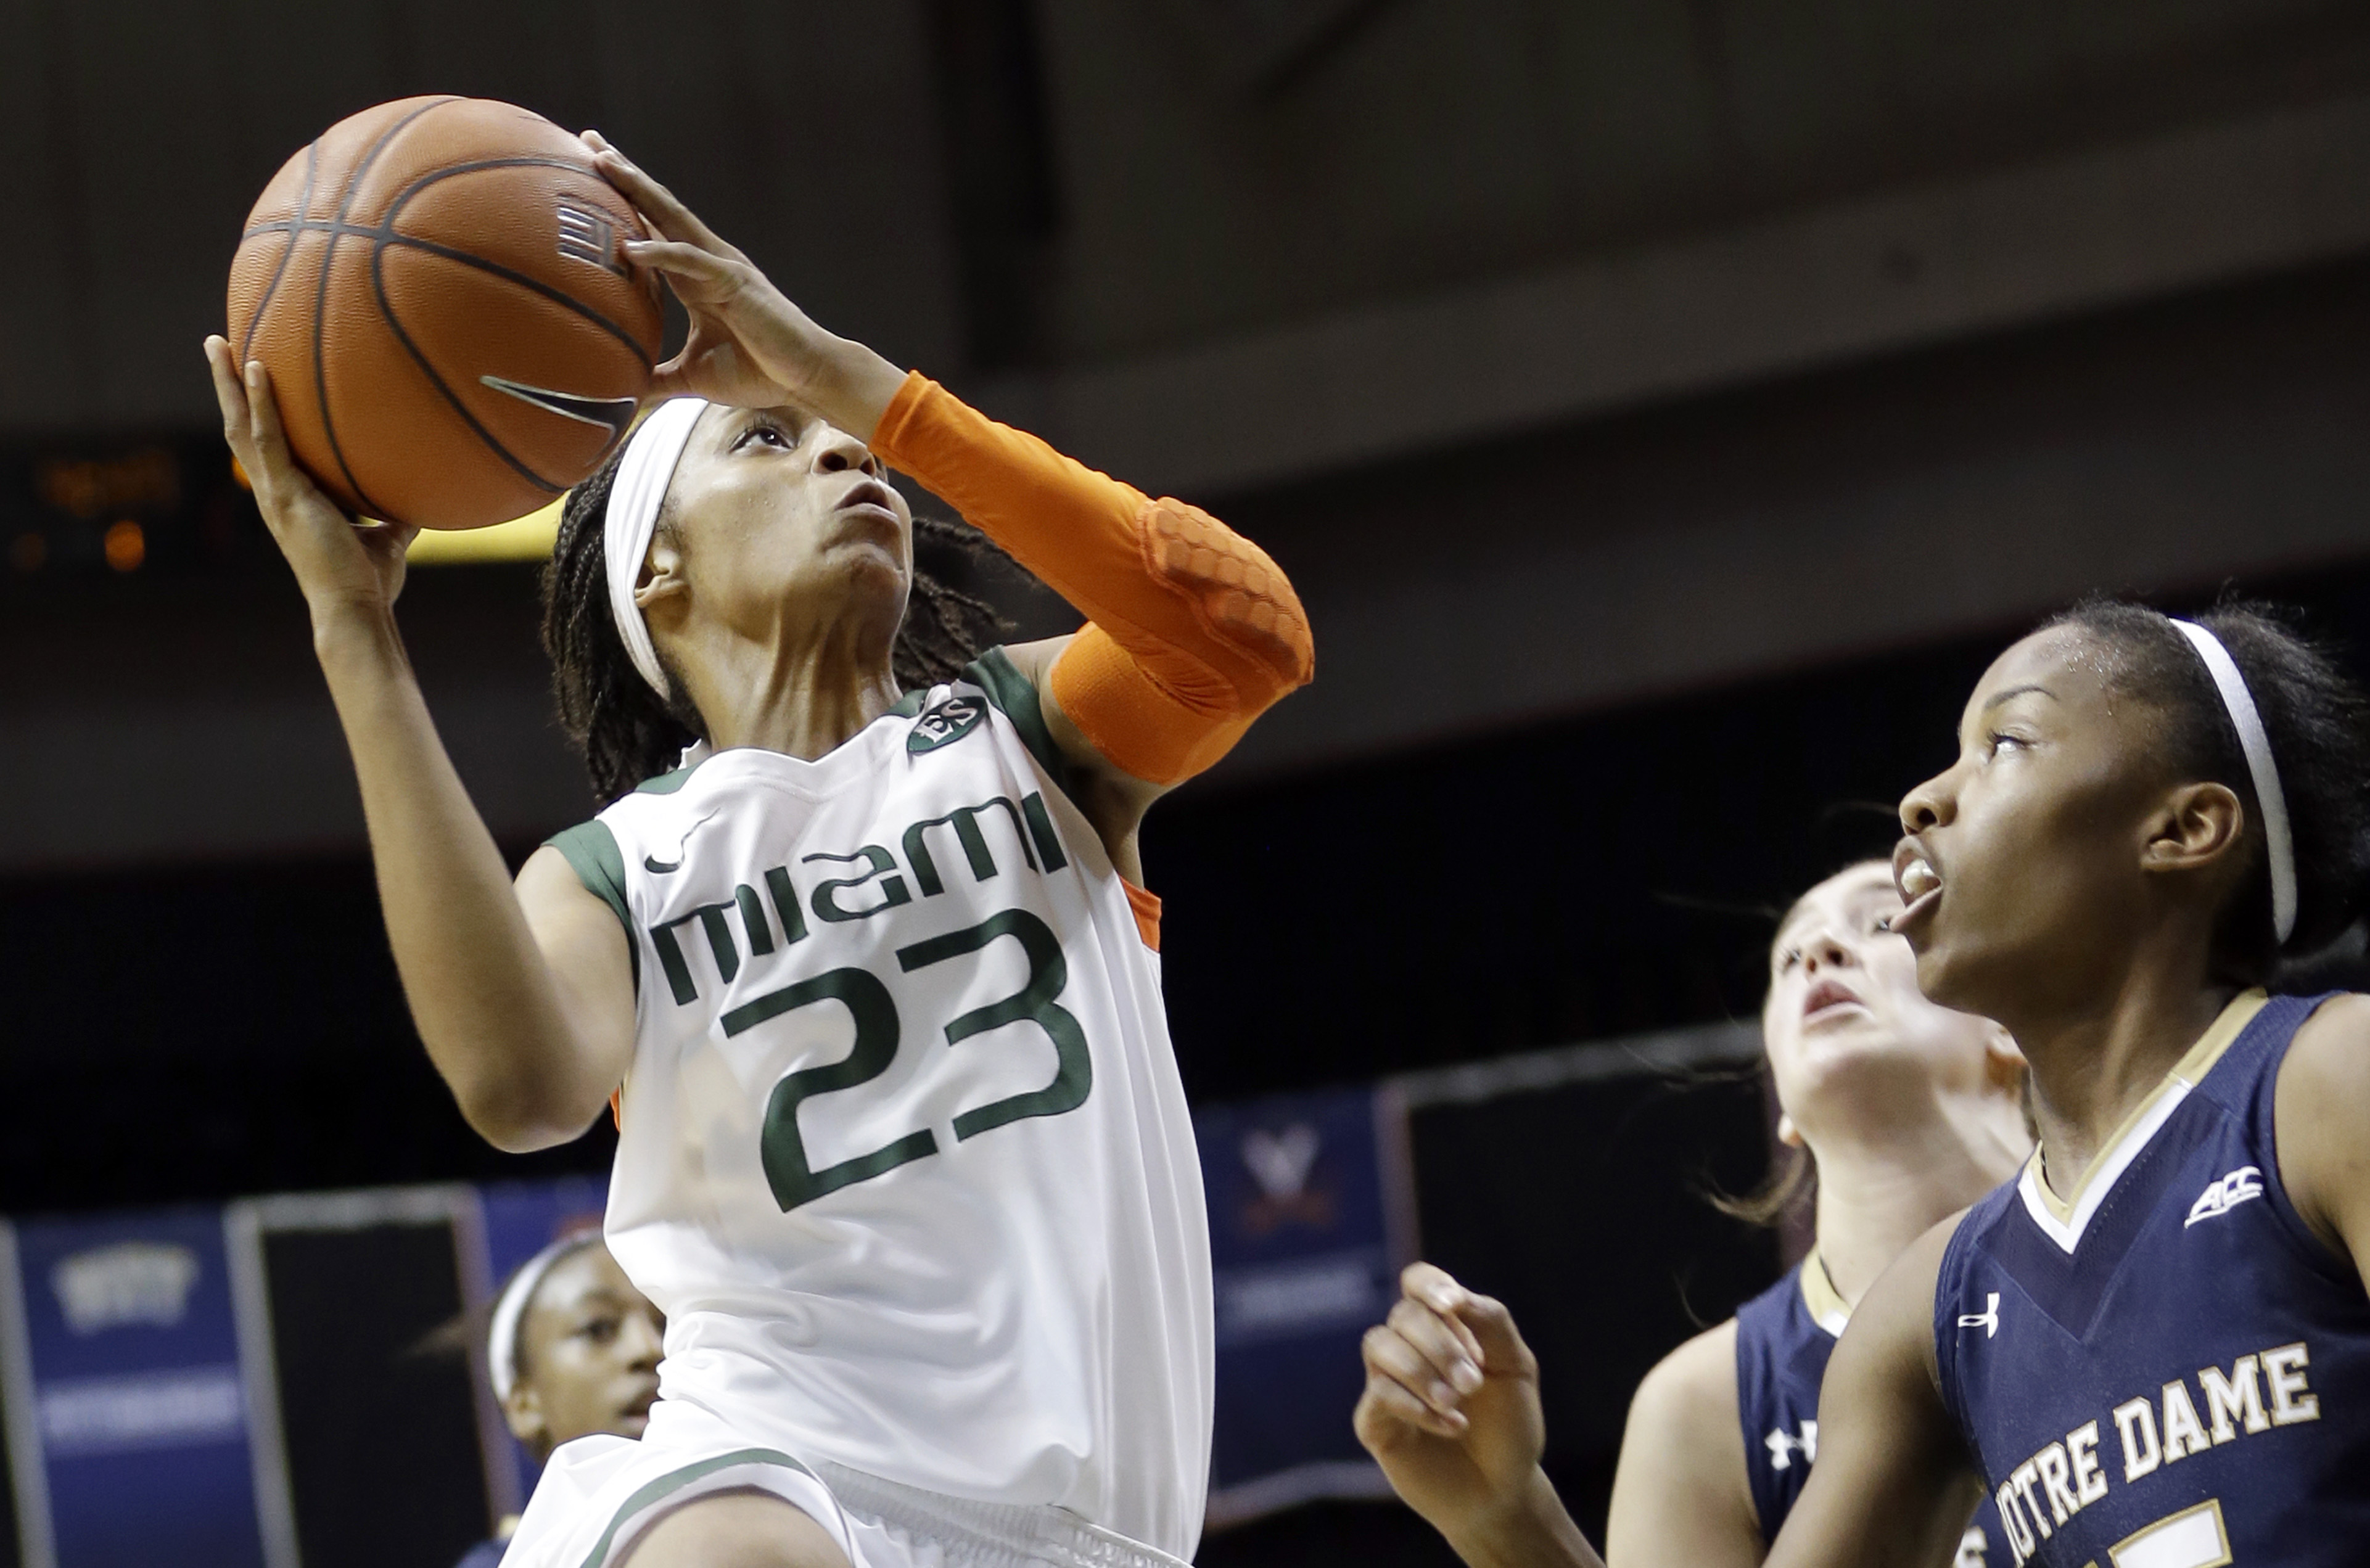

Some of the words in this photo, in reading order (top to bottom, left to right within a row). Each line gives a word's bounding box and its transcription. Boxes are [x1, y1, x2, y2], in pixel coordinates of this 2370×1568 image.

[721, 908, 1093, 1213] 23
[2186, 1165, 2263, 1220] ACC
[1996, 1419, 2109, 1568] OTRE
[2113, 1341, 2321, 1484] DAME
